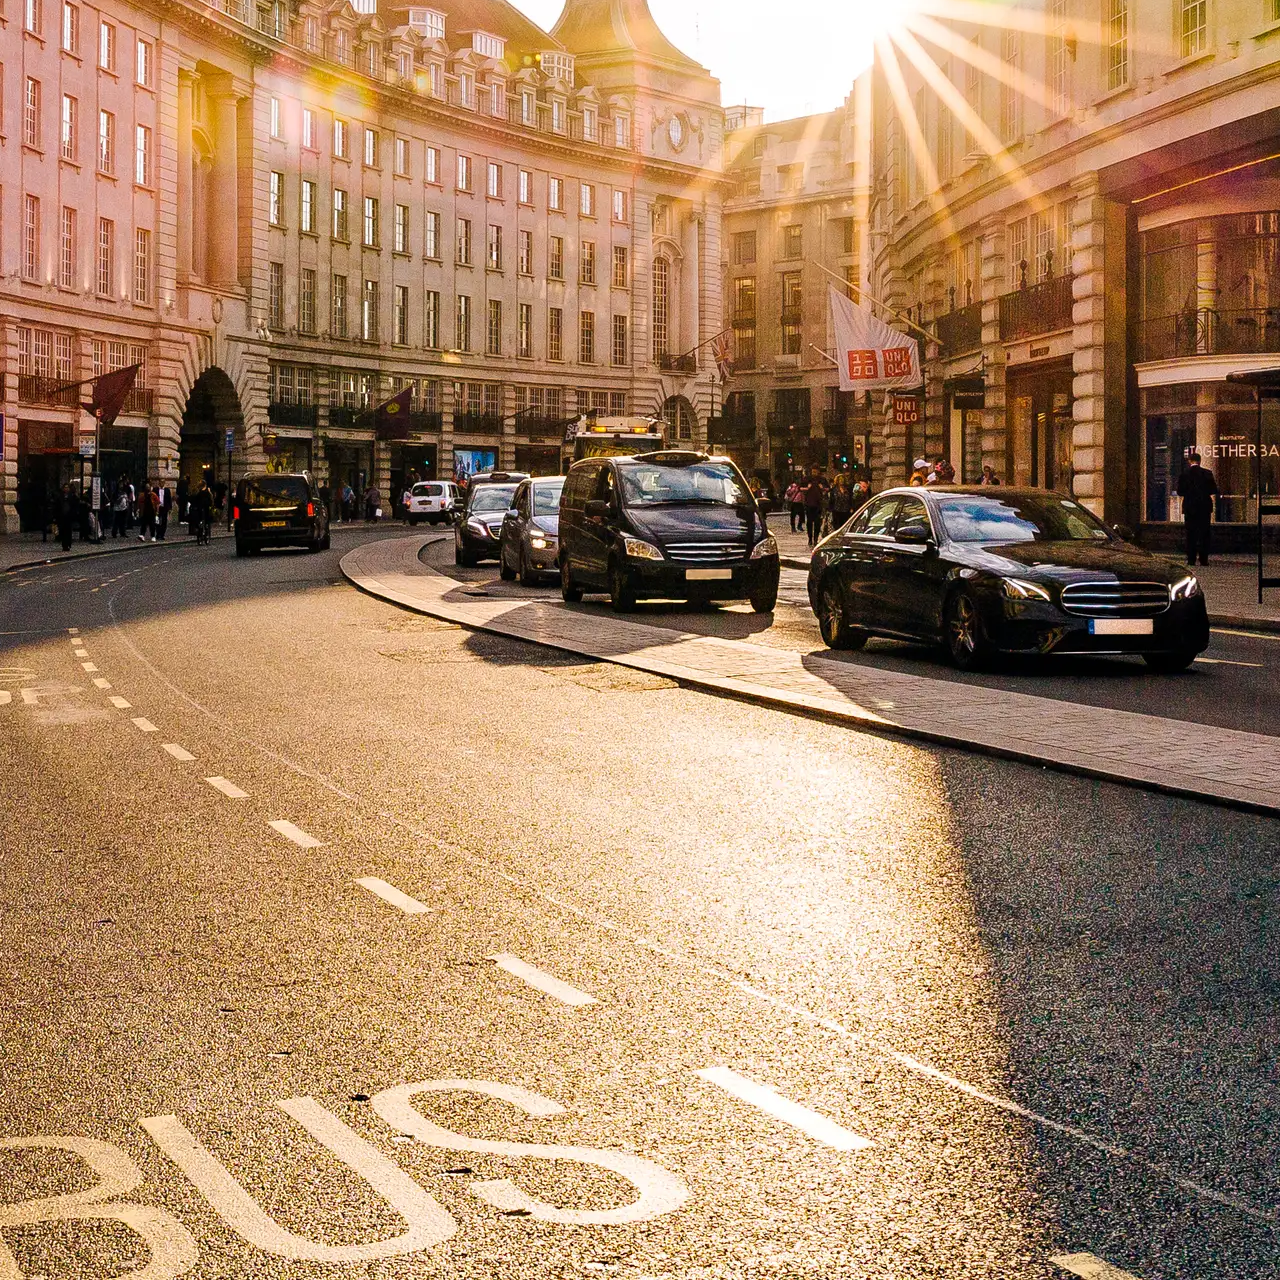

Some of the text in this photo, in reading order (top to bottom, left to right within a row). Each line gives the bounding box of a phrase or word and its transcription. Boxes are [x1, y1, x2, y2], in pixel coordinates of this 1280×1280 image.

[886, 351, 907, 362] UNI
[887, 363, 908, 377] QLO
[896, 401, 916, 410] UNI
[896, 412, 917, 423] QLO
